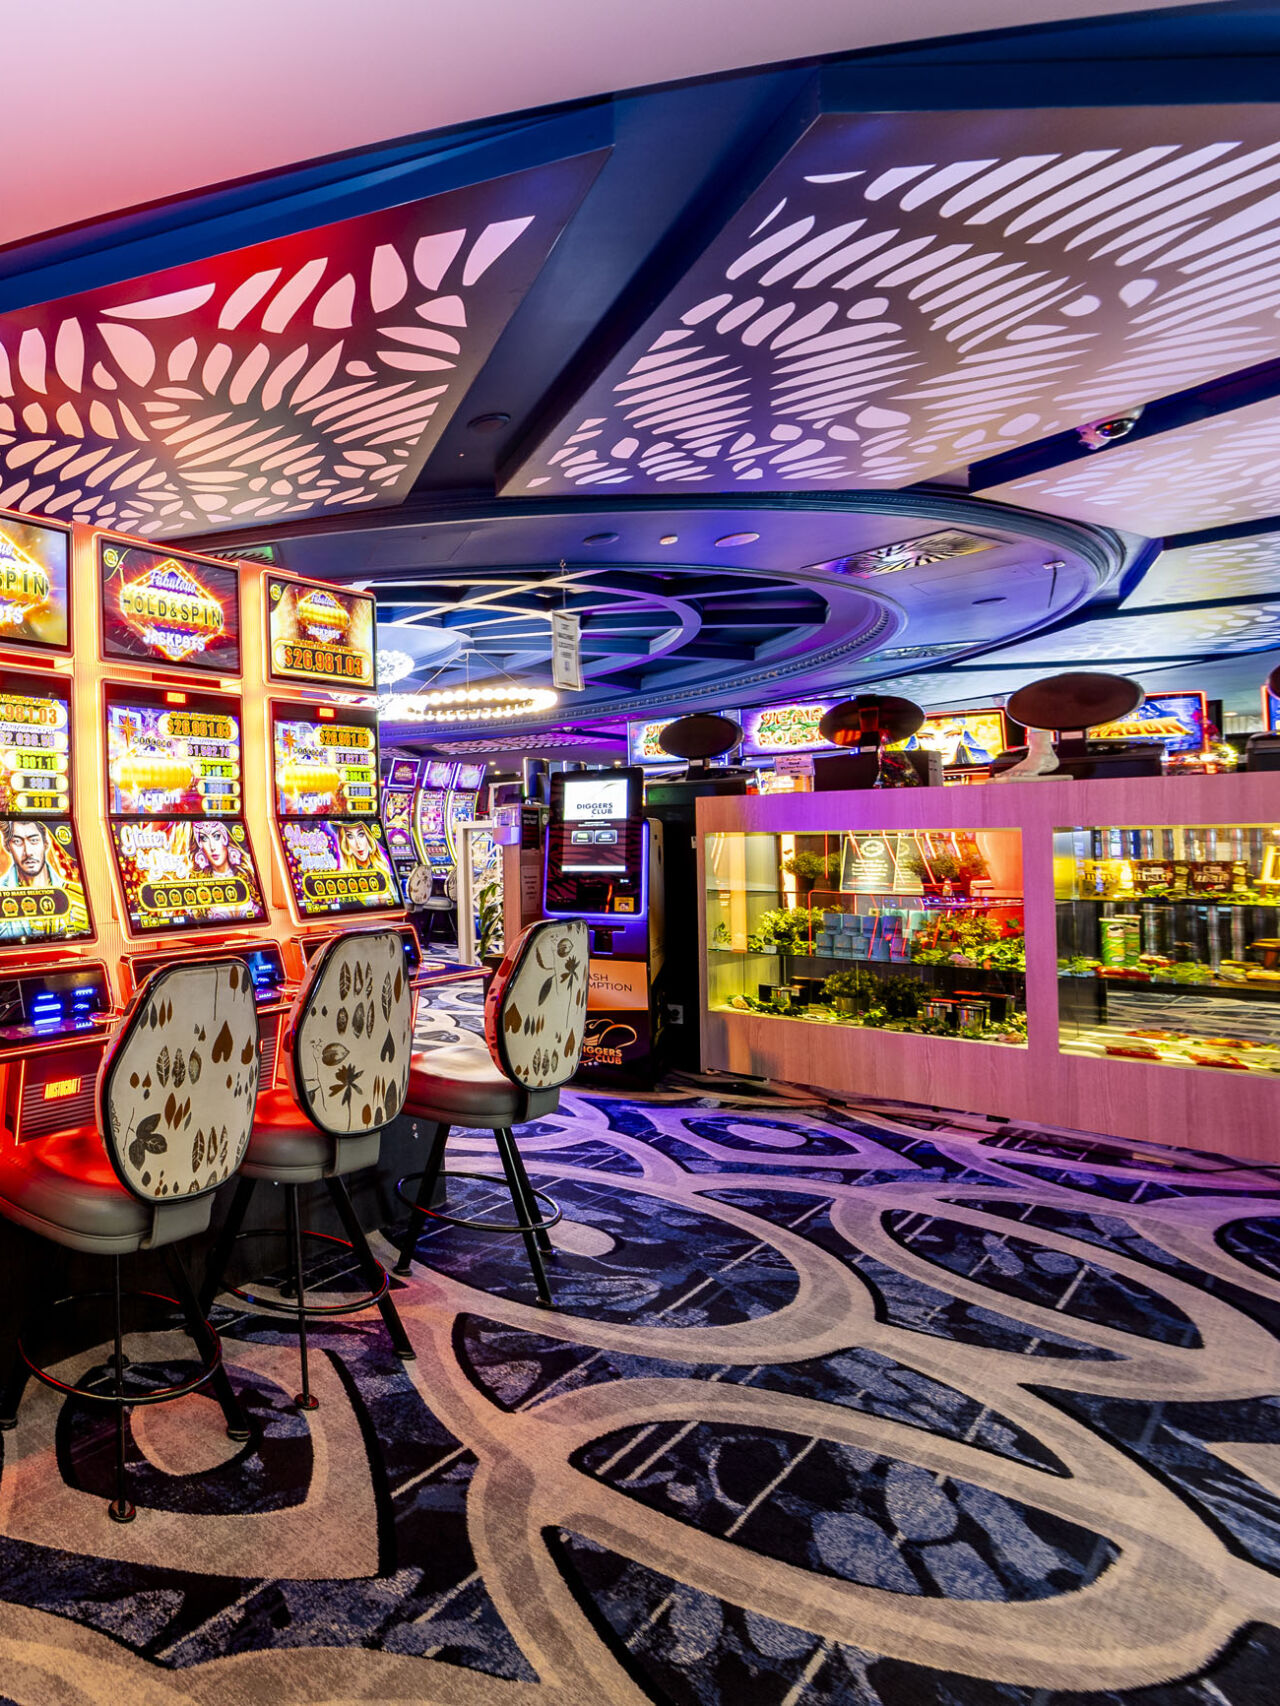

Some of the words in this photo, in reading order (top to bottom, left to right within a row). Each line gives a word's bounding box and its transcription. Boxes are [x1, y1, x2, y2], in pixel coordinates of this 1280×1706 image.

[142, 629, 206, 652] JACKPOTS
[283, 646, 364, 677] $26,981.03
[576, 802, 614, 810] DIGGERS
[27, 888, 55, 896] SELECTION
[583, 1045, 623, 1058] IGGERS
[595, 1055, 622, 1066] CLUB
